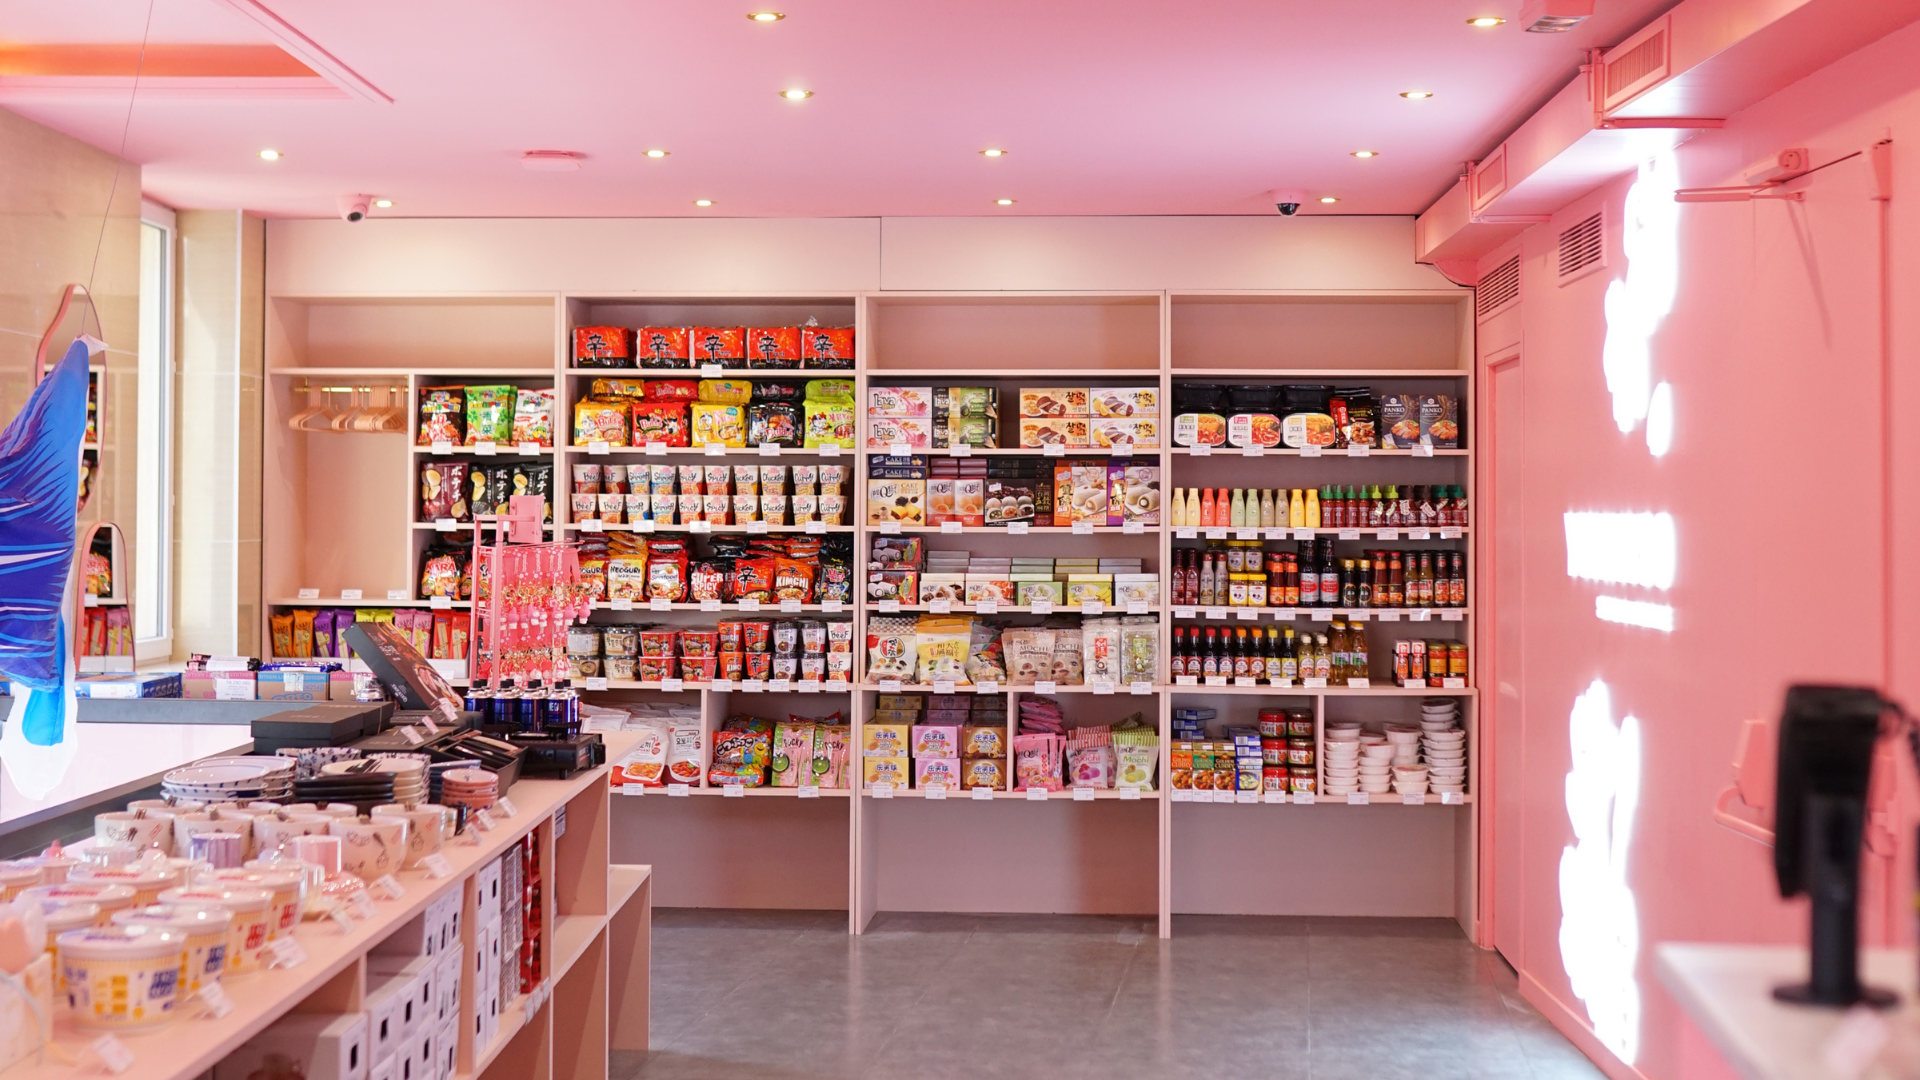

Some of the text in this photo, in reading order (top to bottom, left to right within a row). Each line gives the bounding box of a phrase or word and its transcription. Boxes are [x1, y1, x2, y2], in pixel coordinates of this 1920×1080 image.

[586, 333, 607, 361] 辛
[649, 333, 670, 362] 辛
[704, 333, 724, 362] 辛
[759, 334, 779, 362] 辛
[813, 333, 834, 362] 辛
[450, 465, 463, 502] ポテチ
[495, 469, 508, 504] ポテチ
[425, 563, 456, 571] KARA
[691, 572, 723, 582] SUPER
[737, 566, 758, 592] 辛
[694, 582, 717, 591] SPICY
[775, 576, 809, 588] KIMCHI
[1075, 754, 1100, 764] Mochi
[1122, 755, 1149, 764] Mochi
